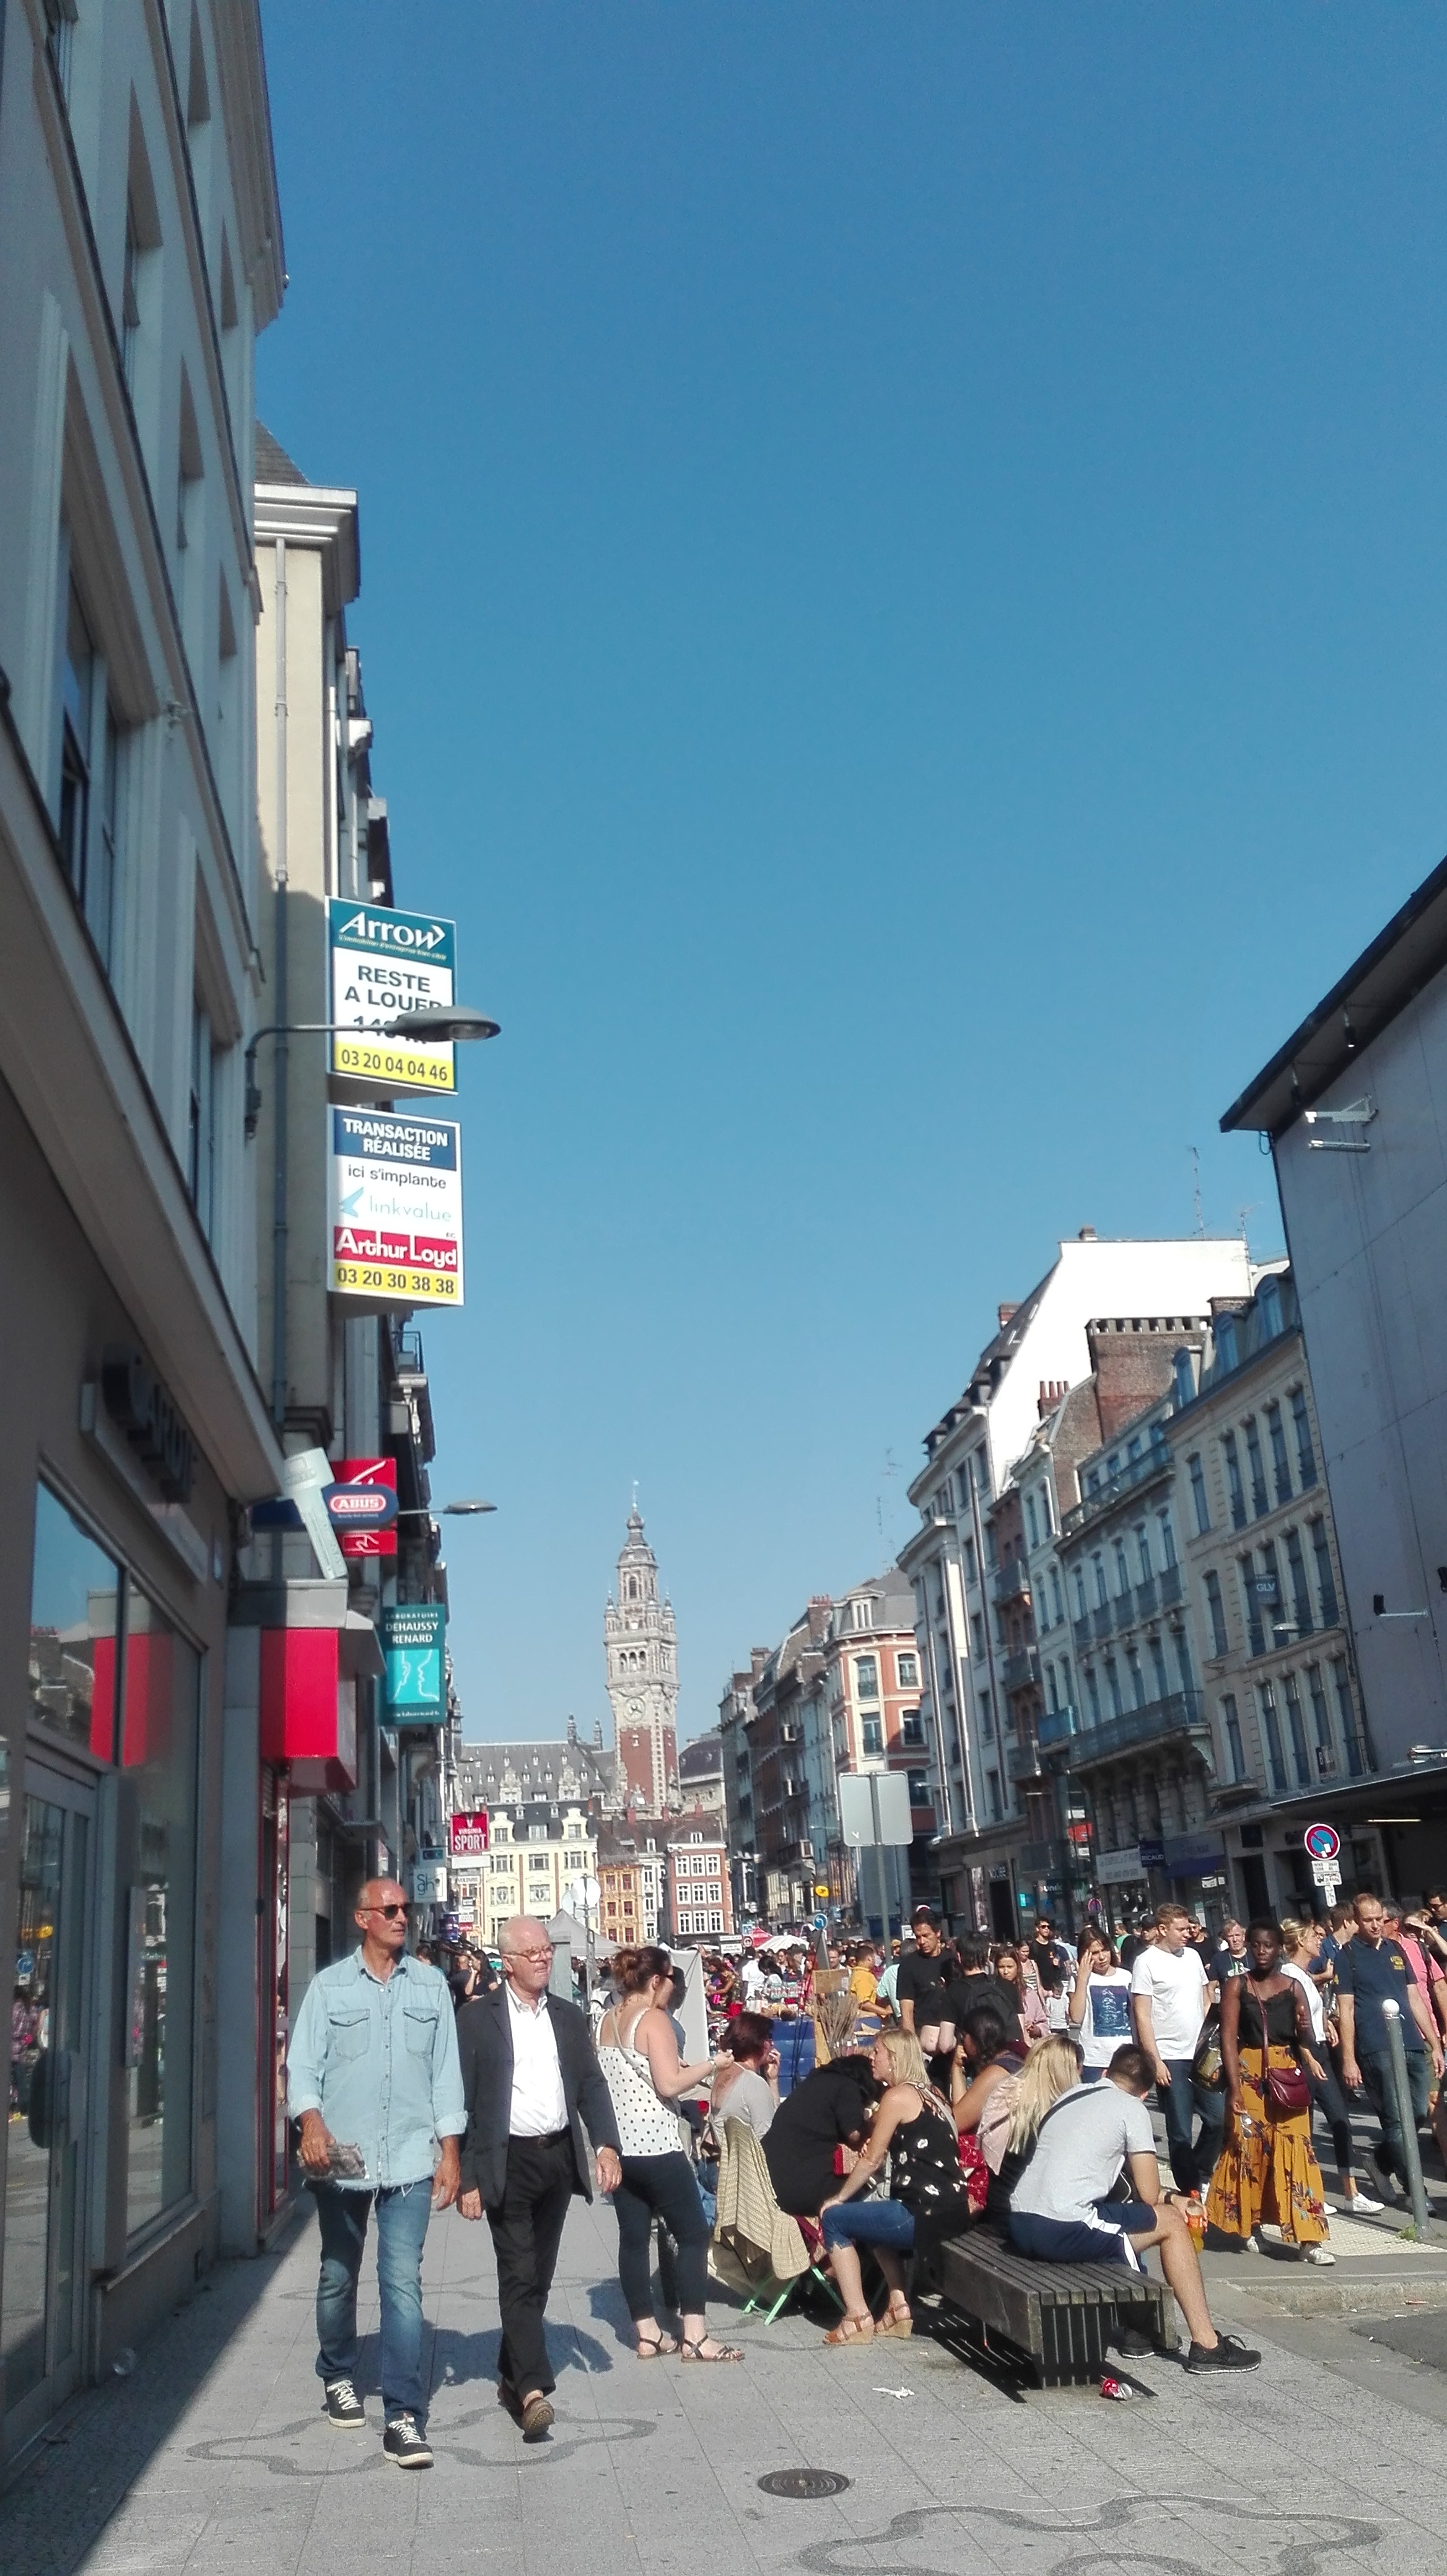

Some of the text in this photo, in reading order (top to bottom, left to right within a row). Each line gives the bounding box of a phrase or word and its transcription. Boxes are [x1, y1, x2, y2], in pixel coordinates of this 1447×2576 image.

[340, 912, 446, 951] Arrow
[358, 965, 431, 993] RESTE
[344, 986, 361, 1003] A
[341, 1049, 447, 1081] 03 20 04 04 46
[343, 1118, 448, 1147] TRANSACTION
[363, 1136, 431, 1161] RÉALISÉE
[348, 1164, 447, 1189] ici s'implante
[369, 1195, 452, 1222] linkvalue
[336, 1229, 457, 1268] Arthur Loyd
[338, 1268, 454, 1294] 03 20 30 38 38
[338, 1499, 379, 1509] ABUS
[1257, 1583, 1275, 1592] GLV
[385, 1622, 439, 1632] DEHAUSSY
[392, 1634, 433, 1644] RENARD
[455, 1834, 487, 1851] SPORT
